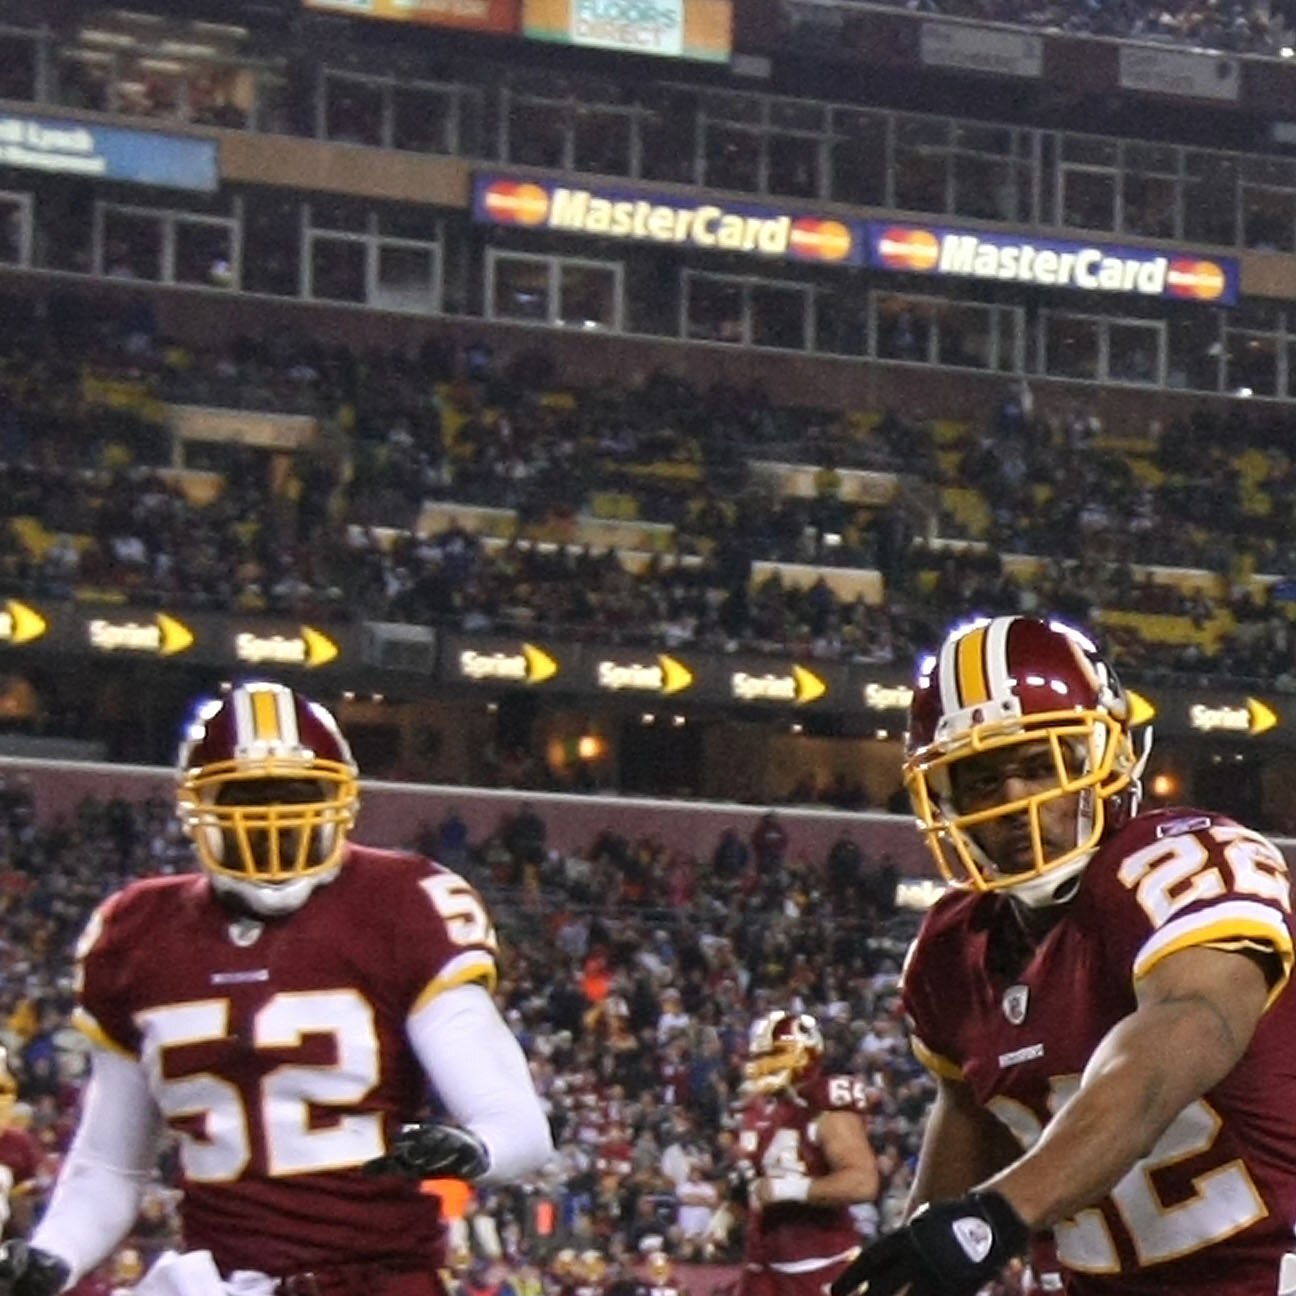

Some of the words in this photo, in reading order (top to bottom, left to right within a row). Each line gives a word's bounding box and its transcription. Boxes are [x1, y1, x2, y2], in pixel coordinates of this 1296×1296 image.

[549, 187, 790, 254] MasterCard
[938, 234, 1168, 294] MasterCard
[417, 872, 499, 950] 5
[1116, 825, 1292, 928] 22
[133, 989, 385, 1182] 52
